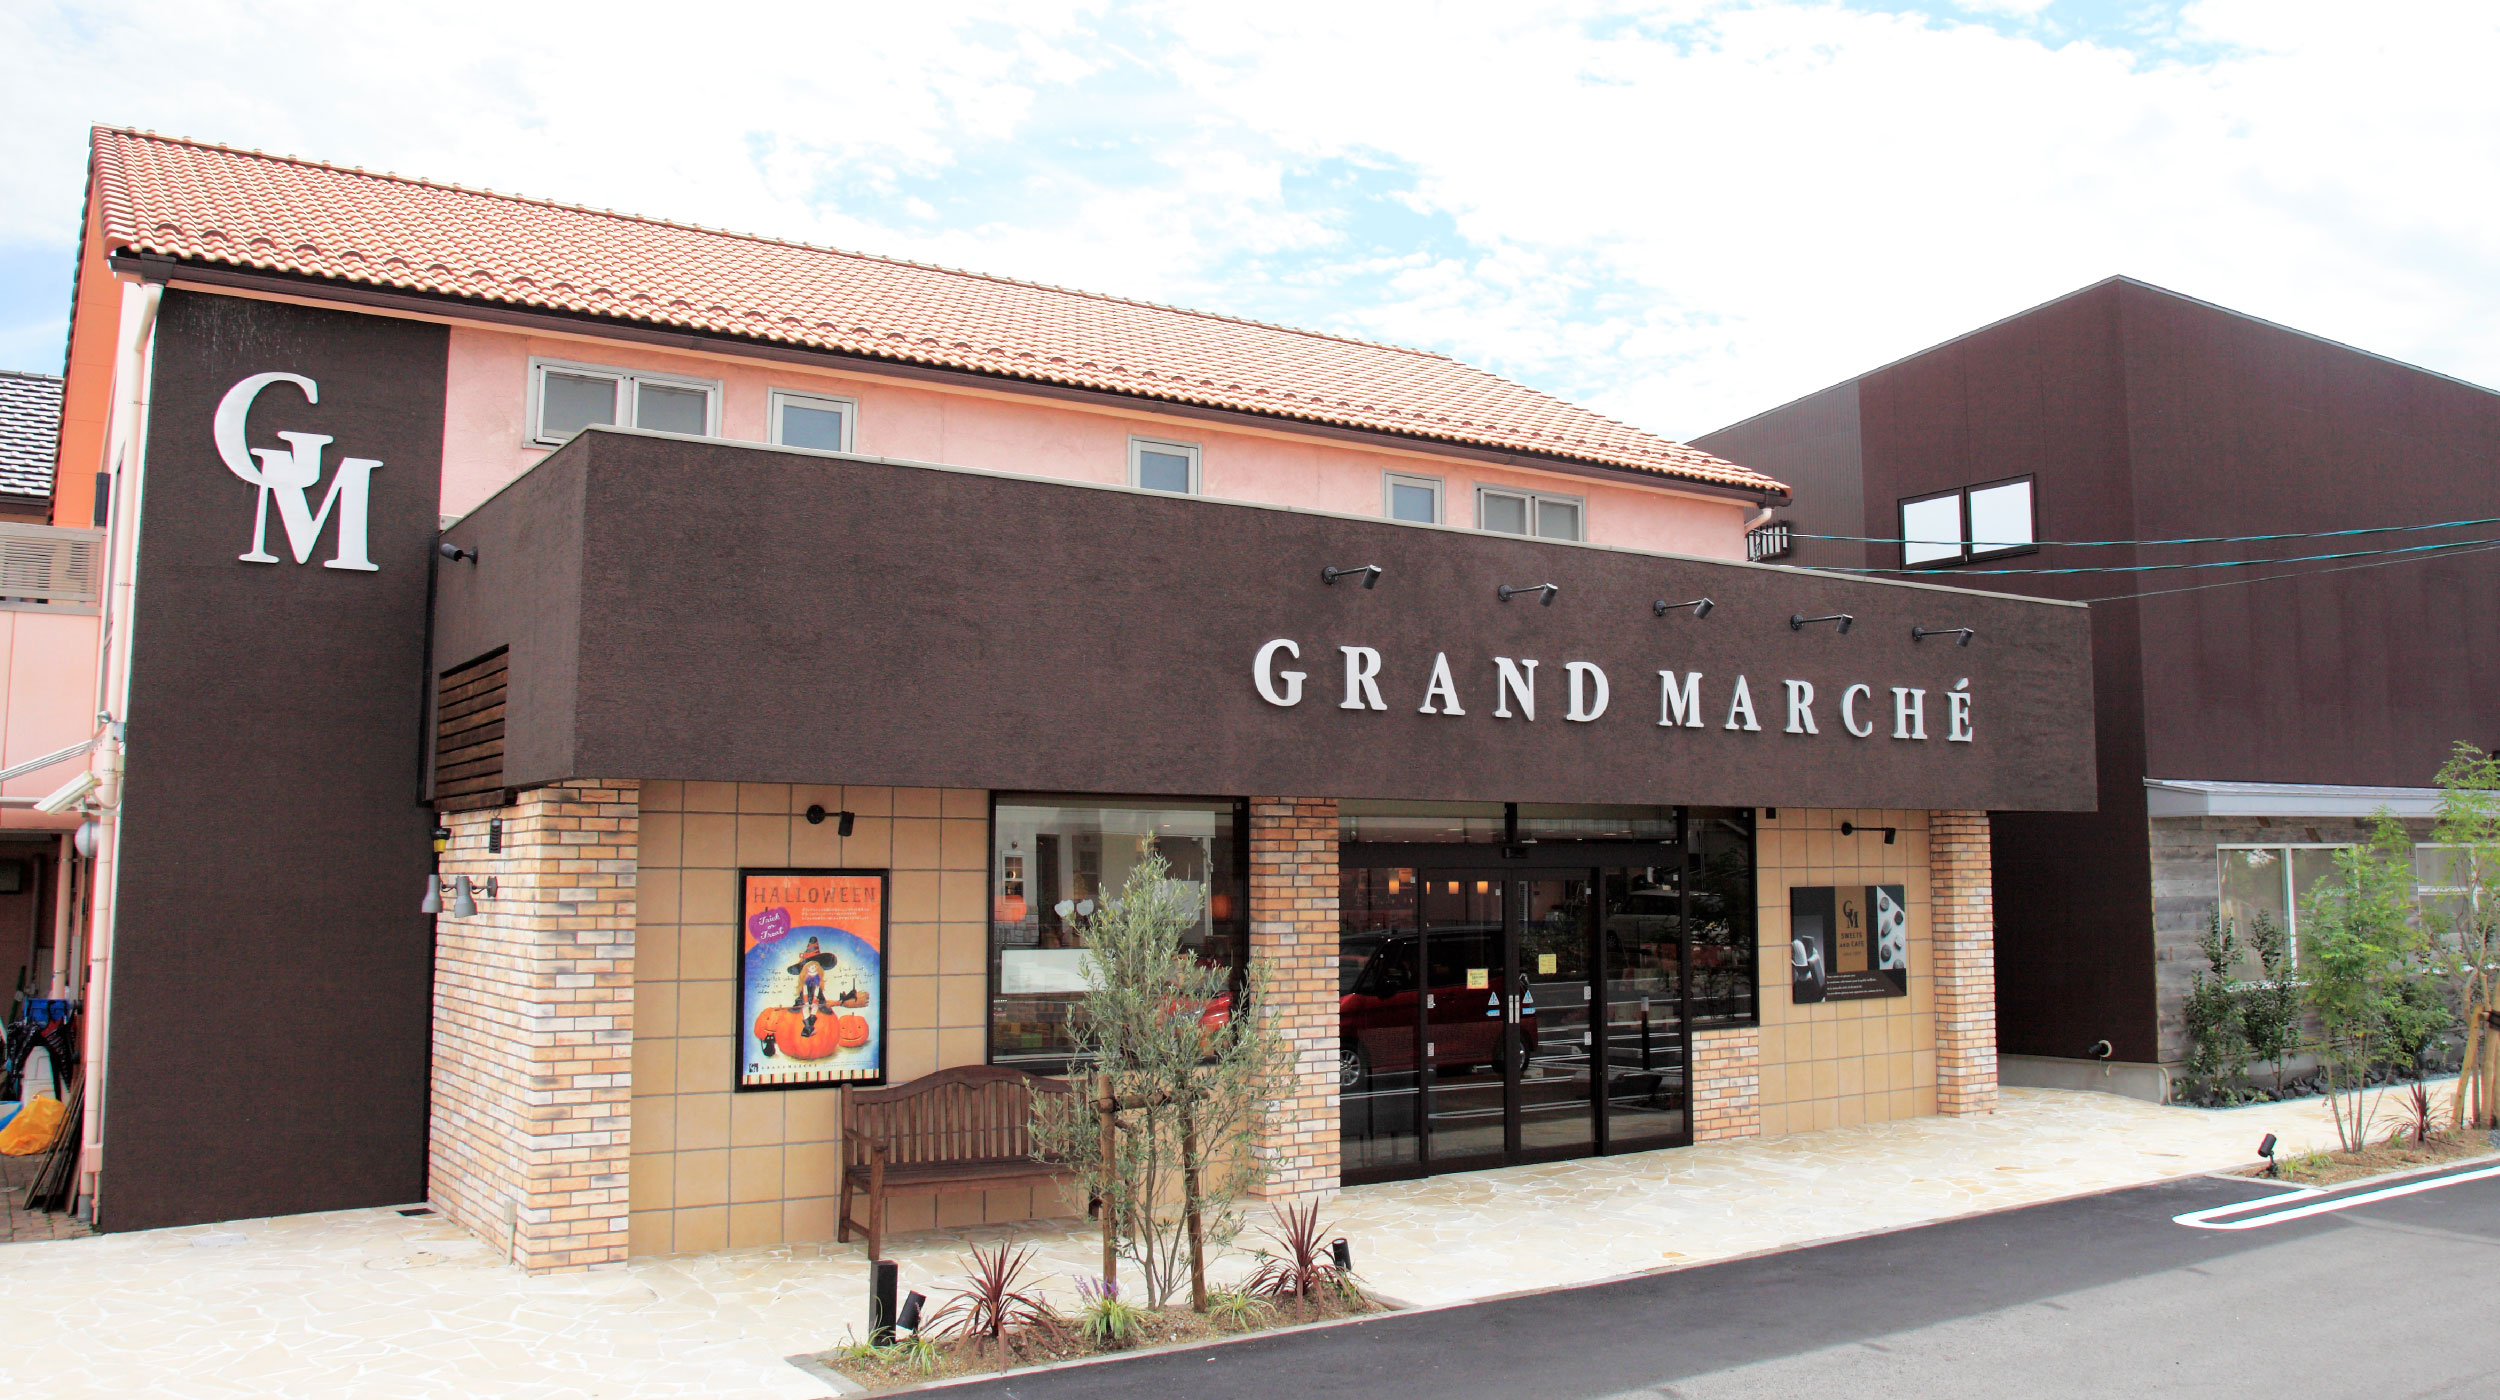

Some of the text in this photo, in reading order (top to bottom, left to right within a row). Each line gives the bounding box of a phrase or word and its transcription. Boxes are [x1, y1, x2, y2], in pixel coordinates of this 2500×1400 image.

[213, 371, 384, 572] GM
[1252, 638, 1974, 742] GRAND MARCHÉ
[753, 886, 876, 904] HALLOWEEN
[758, 912, 781, 926] Trick
[760, 926, 785, 940] Treat
